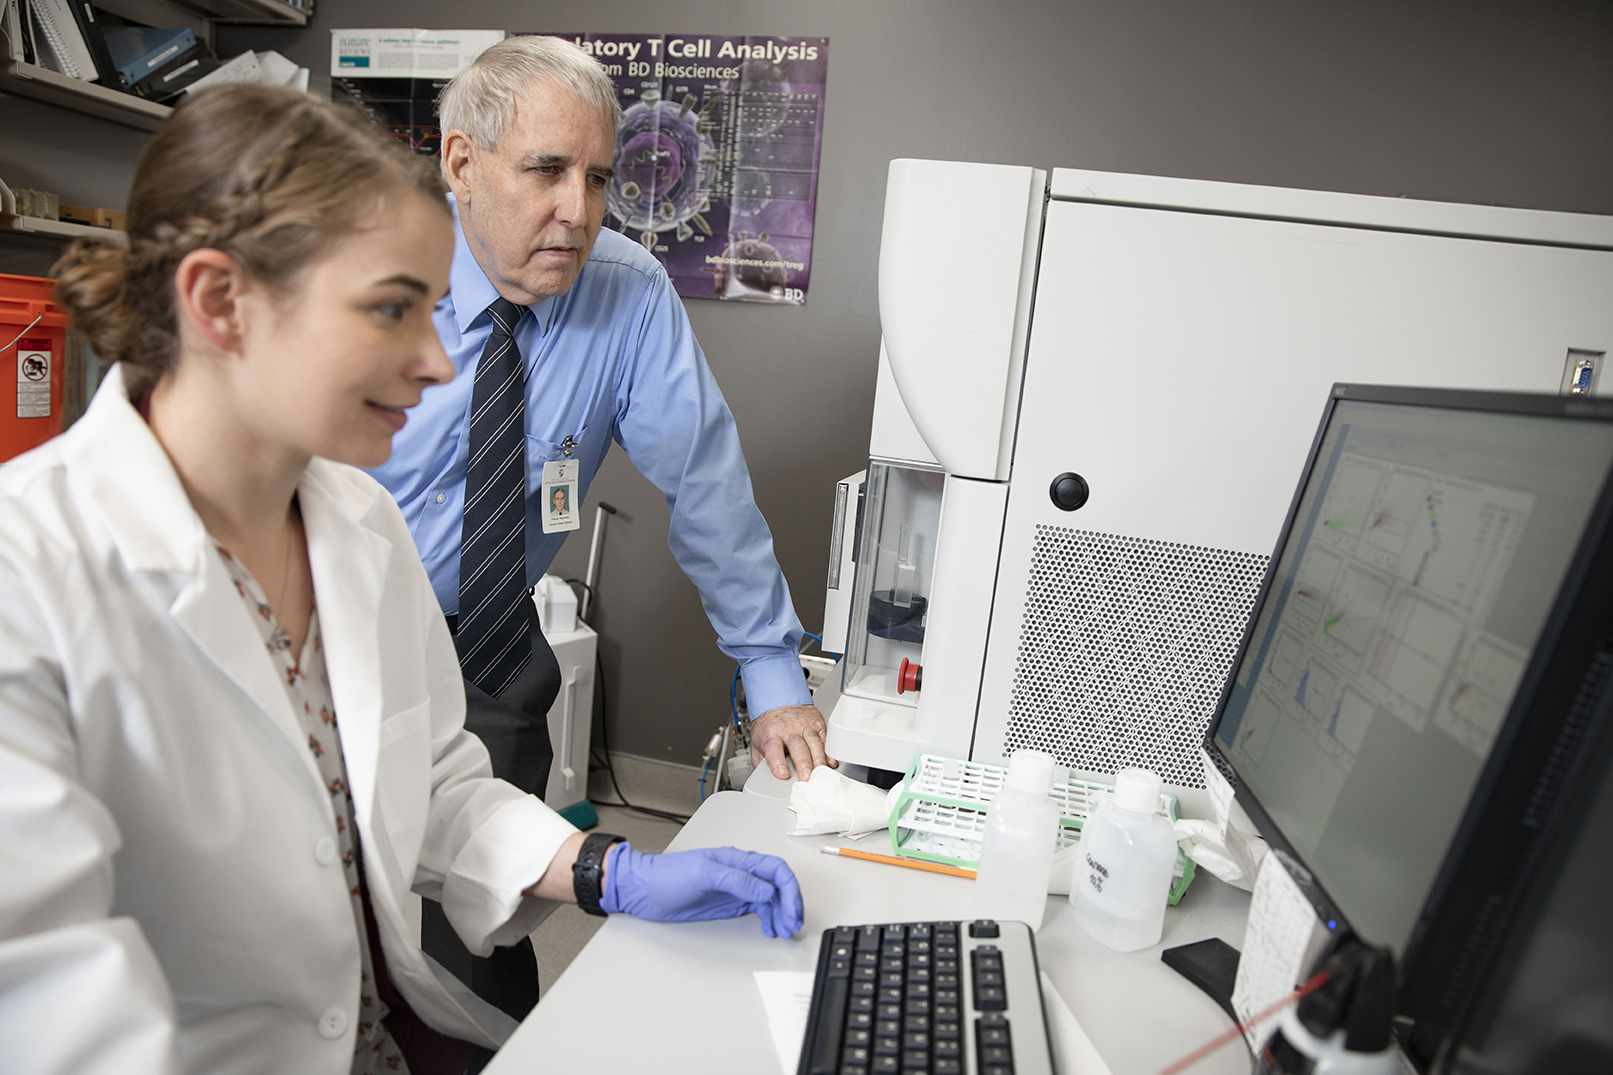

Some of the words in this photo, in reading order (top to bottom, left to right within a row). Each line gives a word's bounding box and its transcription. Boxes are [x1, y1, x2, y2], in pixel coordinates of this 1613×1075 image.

[647, 39, 663, 57] T
[668, 39, 712, 58] Cell
[717, 40, 818, 65] Analysis
[628, 61, 650, 77] BD
[655, 62, 739, 79] Biosciences
[705, 255, 804, 271] bdbiosciences.com/treg
[784, 288, 804, 300] BD
